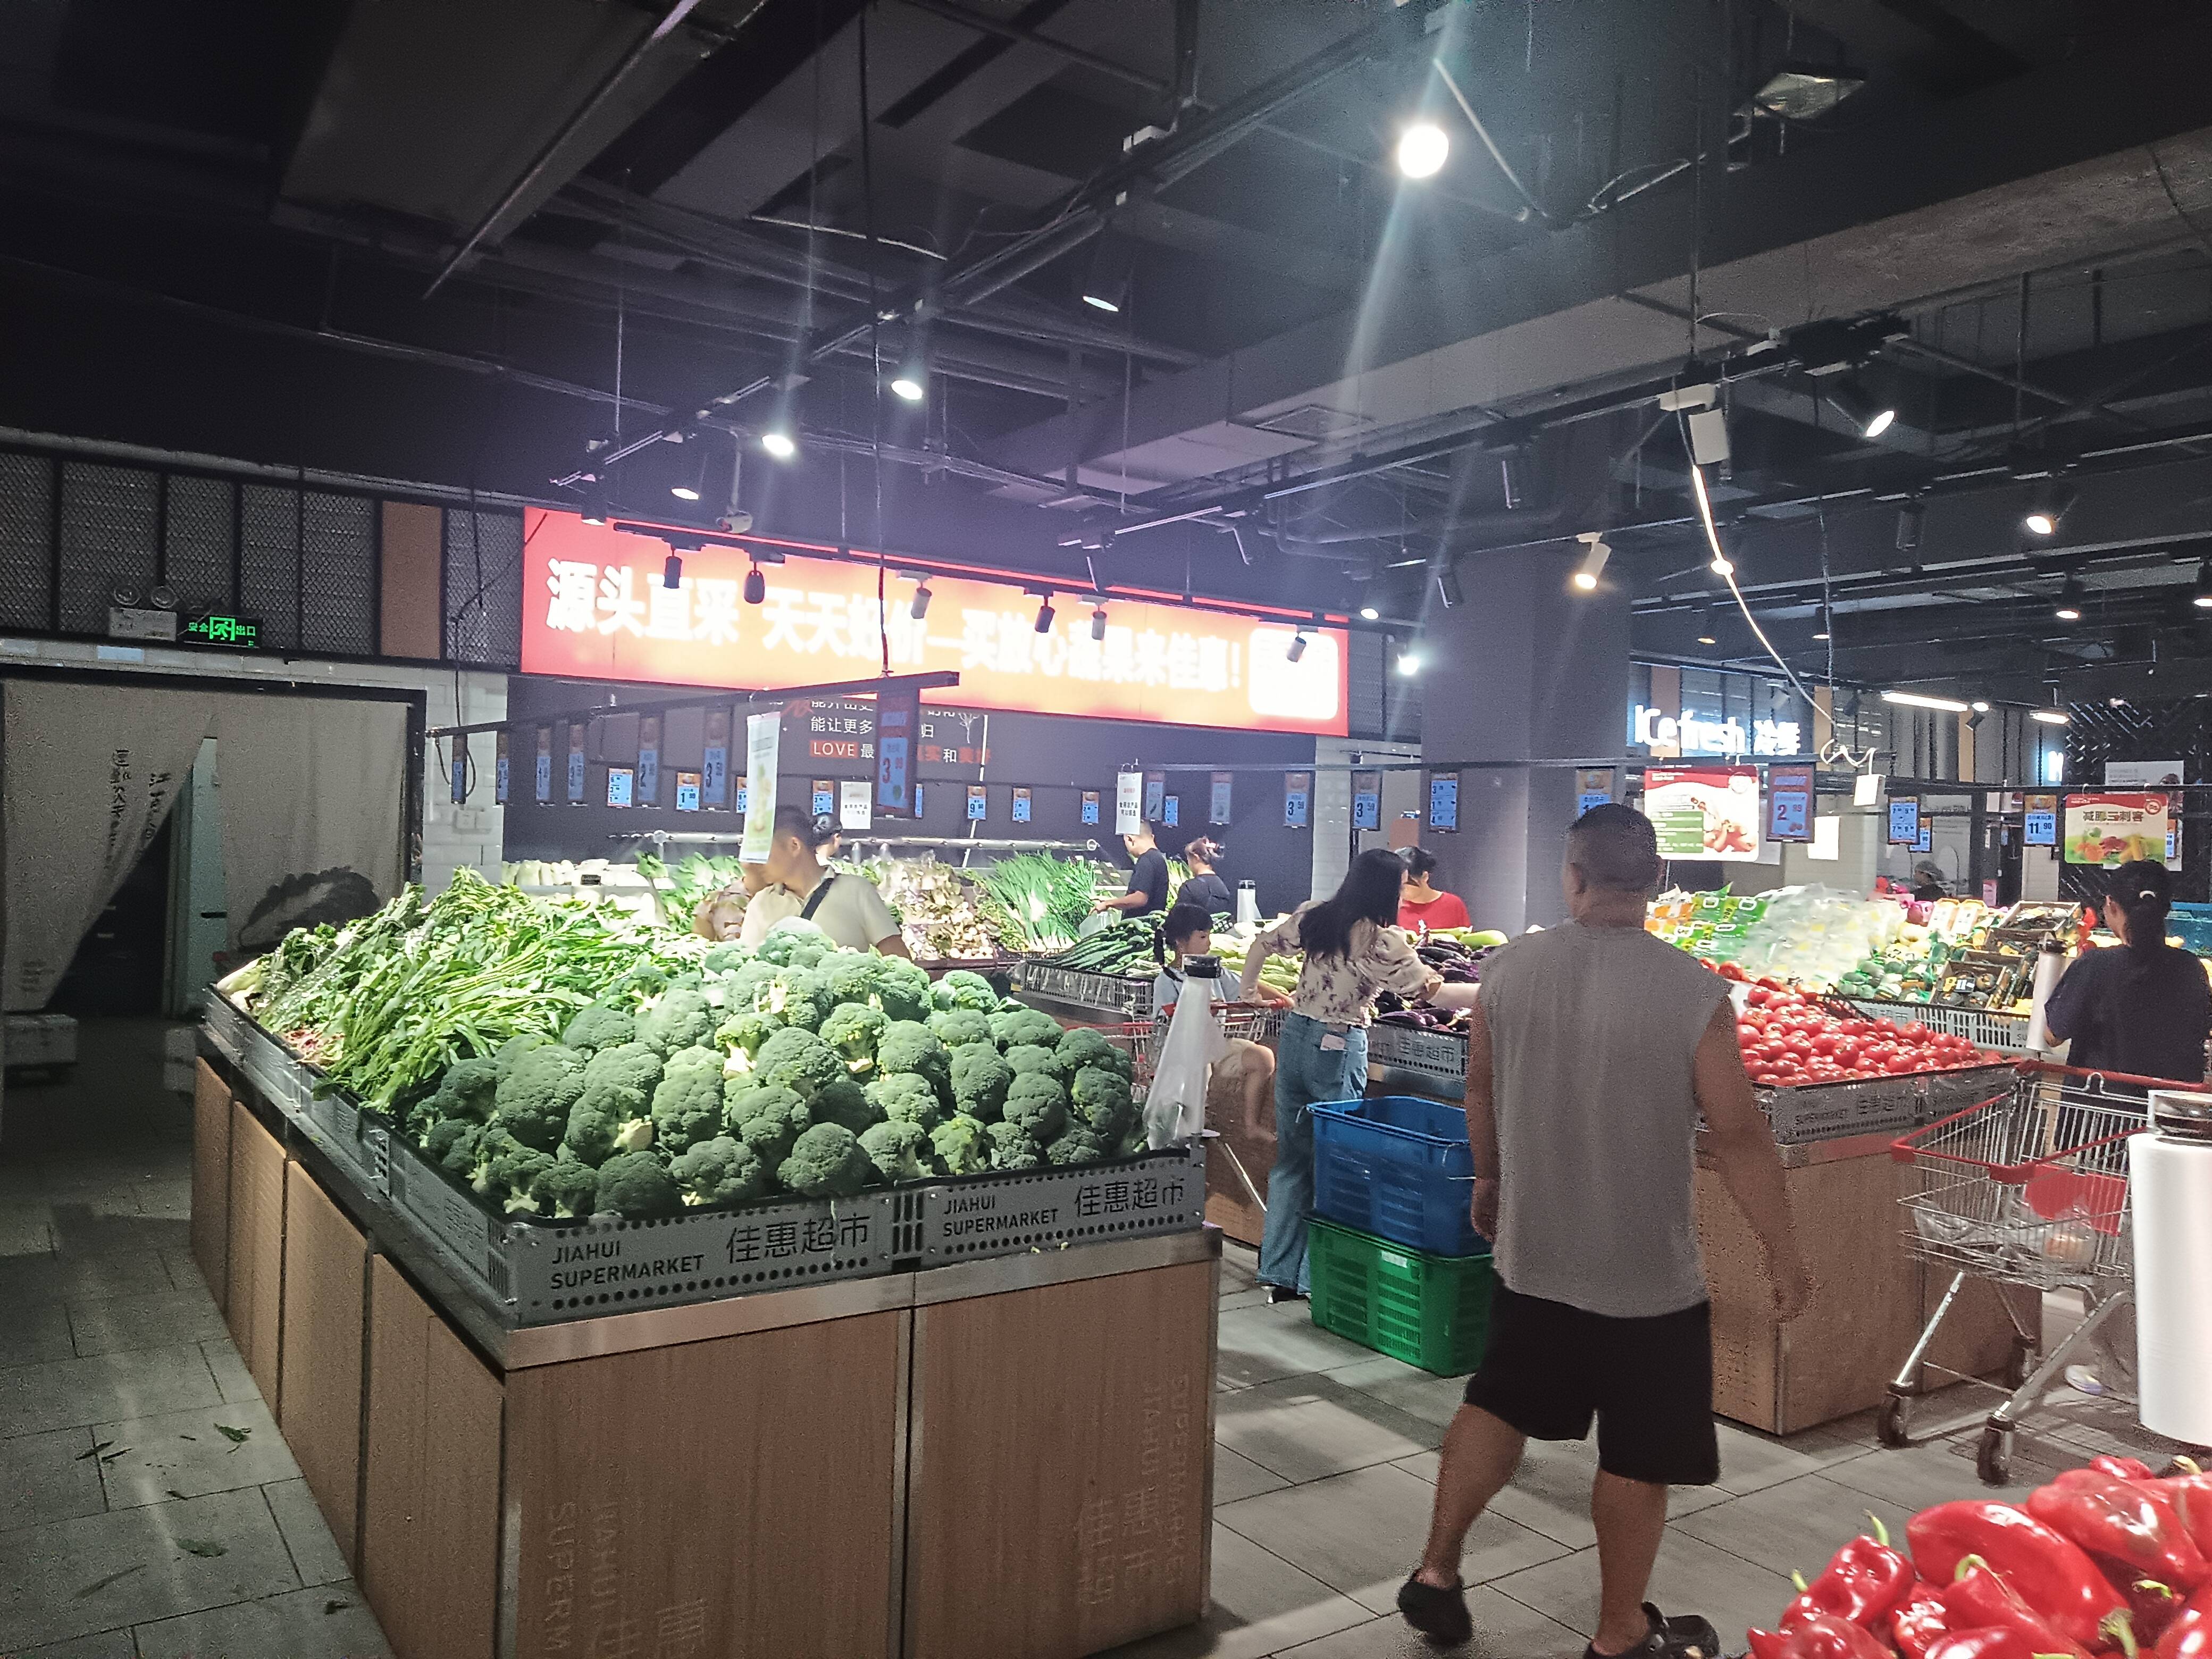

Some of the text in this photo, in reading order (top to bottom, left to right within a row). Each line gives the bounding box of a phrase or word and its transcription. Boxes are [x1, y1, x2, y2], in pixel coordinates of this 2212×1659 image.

[236, 625, 256, 636] 出口
[811, 716, 873, 734] 能让更多
[814, 742, 854, 757] LOVE
[944, 1194, 996, 1215] JIAHUI
[1074, 1178, 1185, 1218] 佳惠超市
[942, 1208, 1059, 1237] SUPERMARKET
[726, 1212, 873, 1265] 佳惠超市
[551, 1241, 620, 1265] JIAHUI
[550, 1254, 705, 1290] SUPERMARKET
